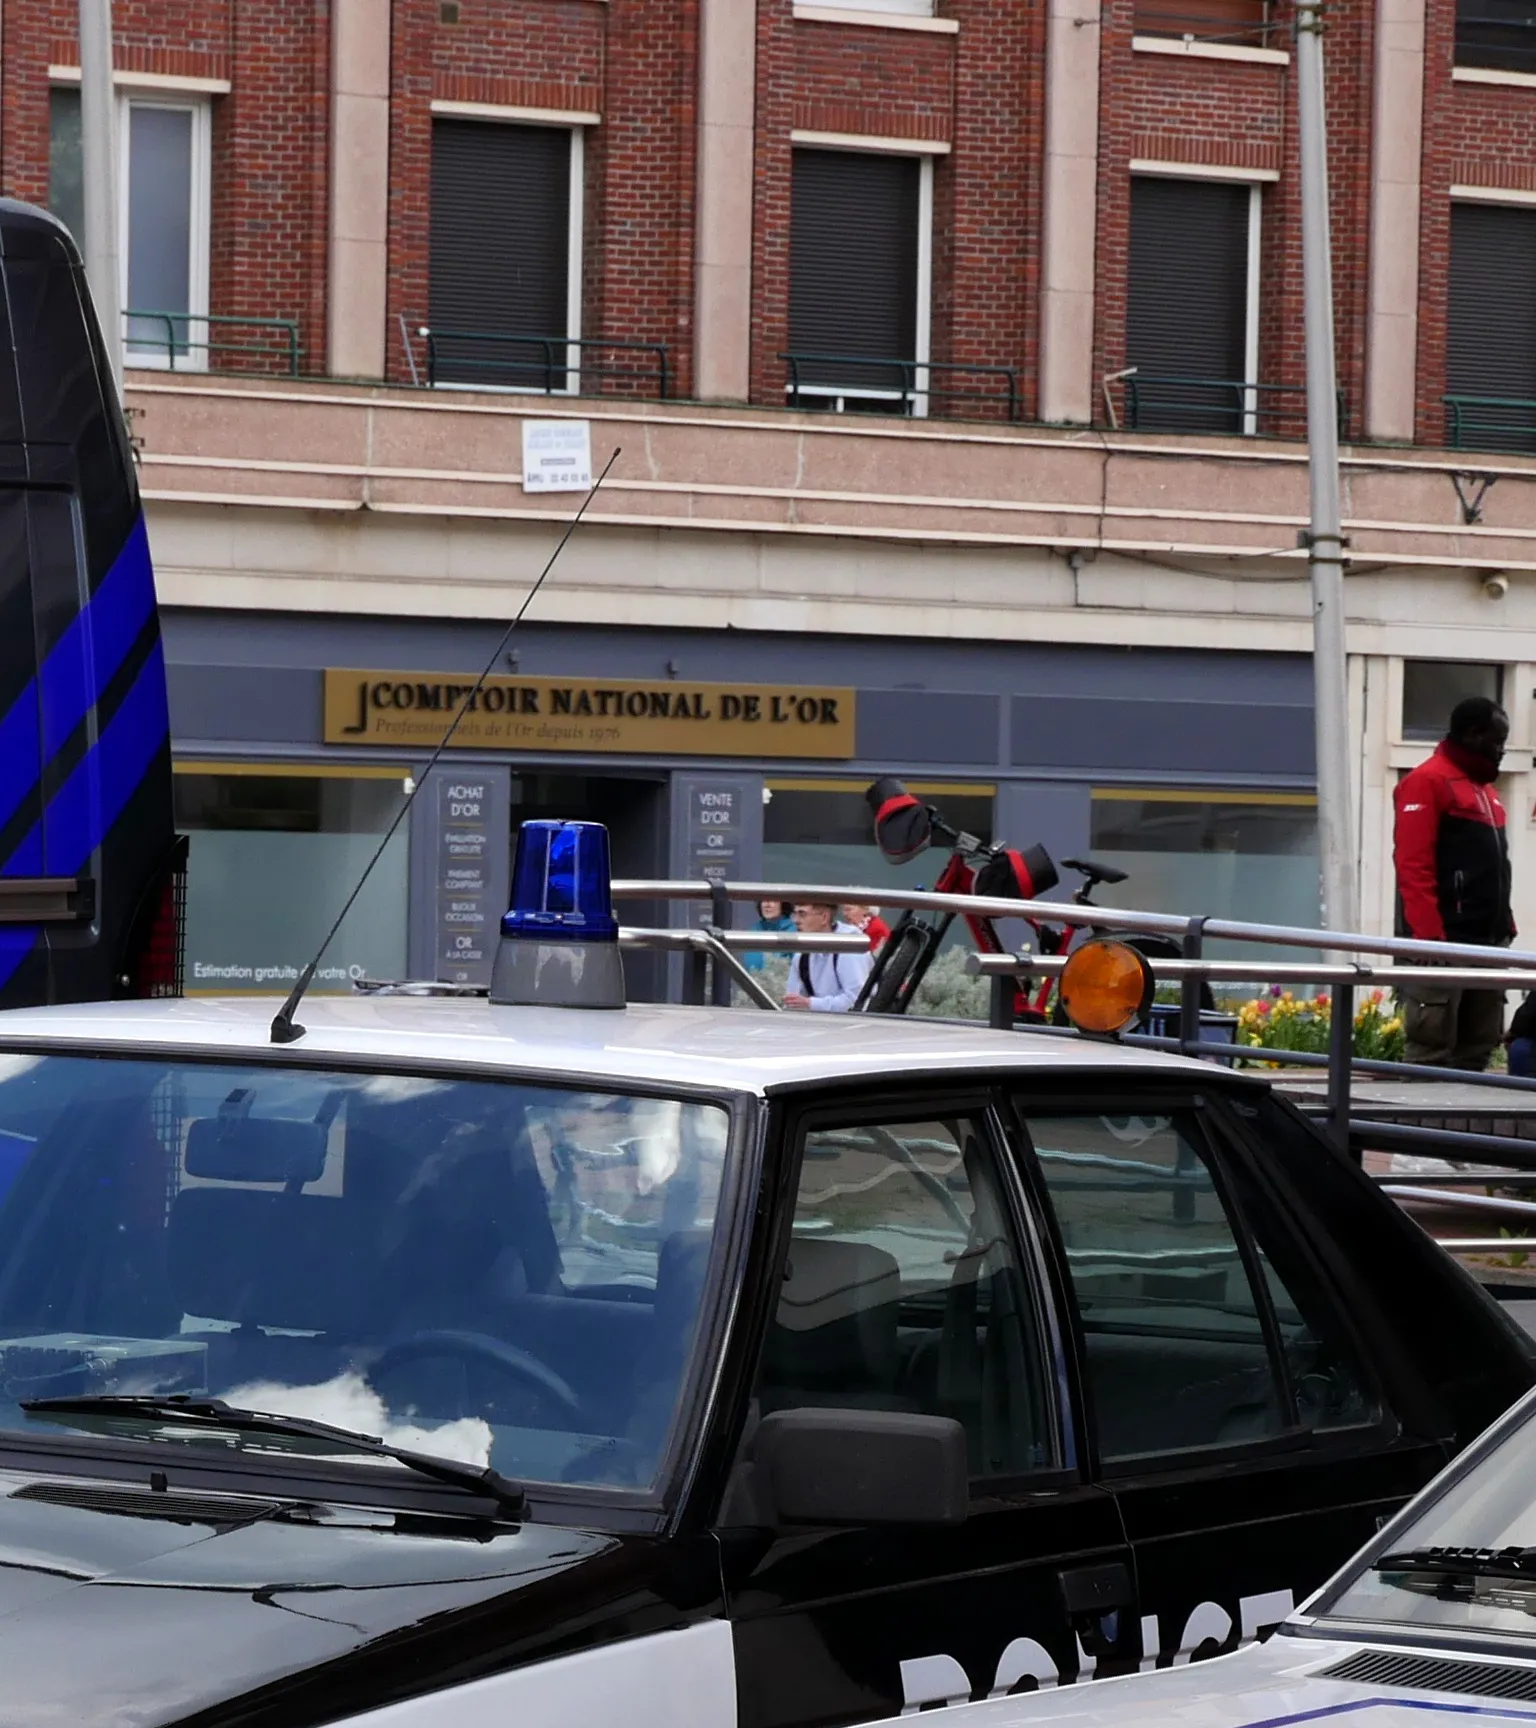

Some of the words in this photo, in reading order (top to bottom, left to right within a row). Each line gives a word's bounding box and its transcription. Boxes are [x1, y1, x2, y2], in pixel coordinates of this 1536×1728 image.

[371, 682, 539, 713] COMPTOIR
[549, 688, 711, 720] NATIONAL
[720, 694, 761, 722] DE
[770, 695, 839, 725] L'OR
[536, 723, 584, 742] depuis
[448, 786, 484, 799] ACHAT
[699, 793, 732, 806] VENTE
[451, 803, 480, 816] D'OR
[701, 811, 730, 824] D'OR
[707, 835, 724, 847] OR
[456, 936, 473, 949] OR
[194, 962, 252, 978] Estimation
[255, 964, 297, 982] gratuite
[319, 967, 347, 979] votre
[349, 963, 366, 979] Or
